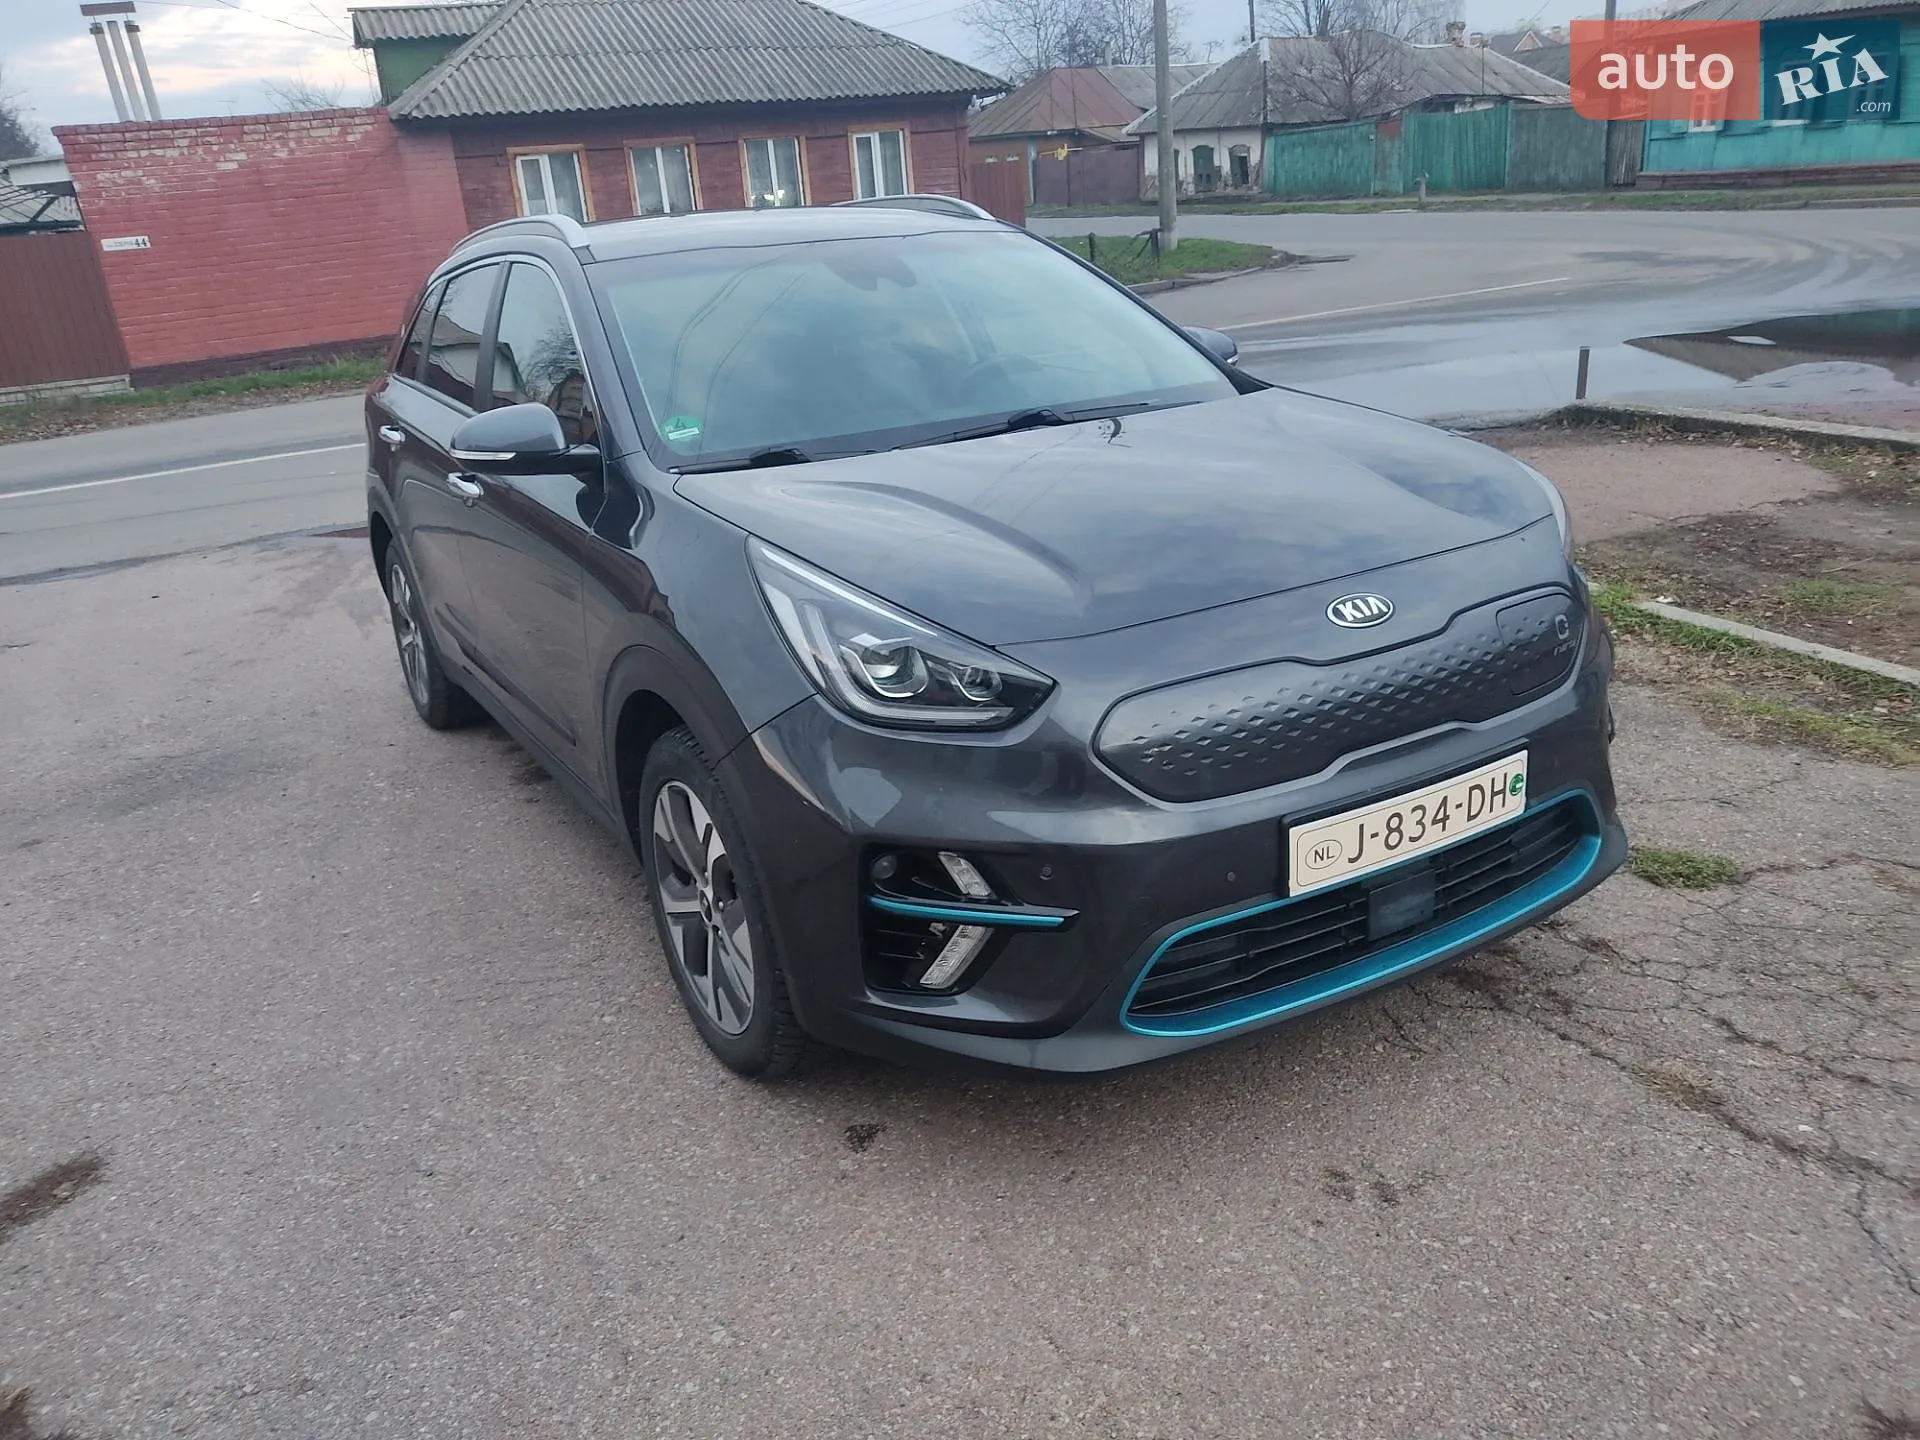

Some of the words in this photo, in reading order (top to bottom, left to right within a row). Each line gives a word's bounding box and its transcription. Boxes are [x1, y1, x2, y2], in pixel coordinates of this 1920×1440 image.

[135, 238, 147, 247] 44
[1335, 596, 1389, 622] KIA
[1313, 847, 1335, 864] NL
[1347, 772, 1508, 864] J-834-DH
